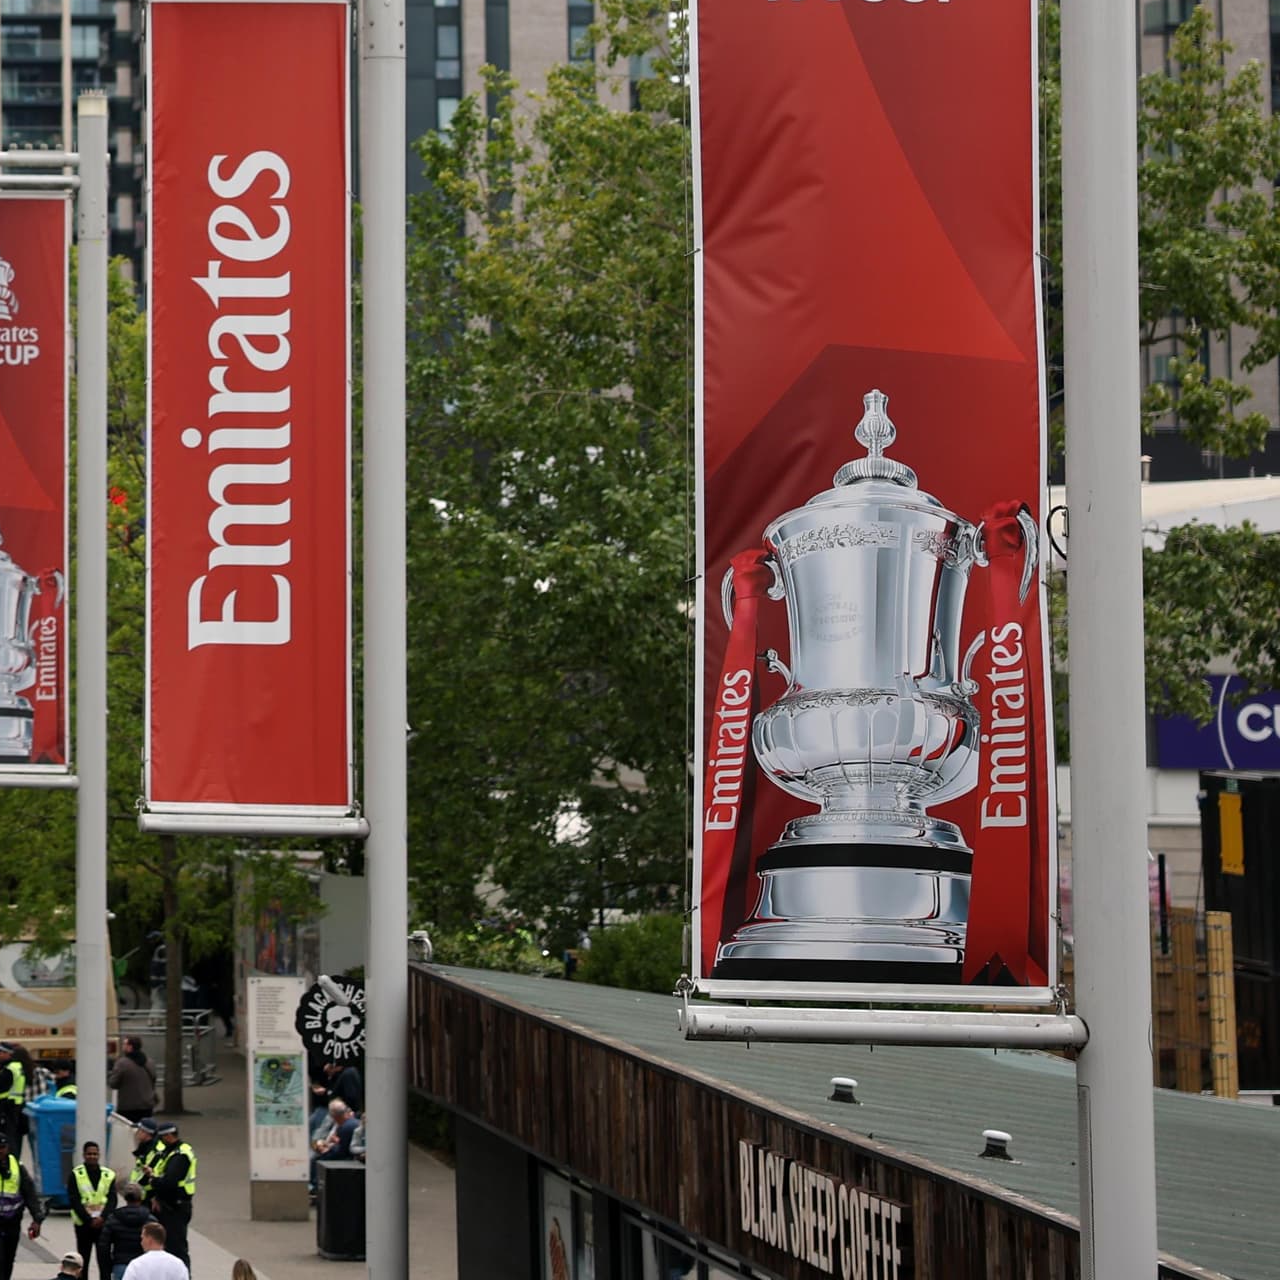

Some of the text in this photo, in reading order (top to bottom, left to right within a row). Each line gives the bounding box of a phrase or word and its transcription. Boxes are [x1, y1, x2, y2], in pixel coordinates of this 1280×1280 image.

[181, 150, 292, 651] Emirates
[36, 616, 57, 701] Emirates
[980, 621, 1027, 829] Emirates
[1237, 703, 1280, 743] C
[705, 668, 751, 833] Emirates
[739, 1140, 788, 1252] BLACK
[790, 1161, 837, 1275] SHEEP
